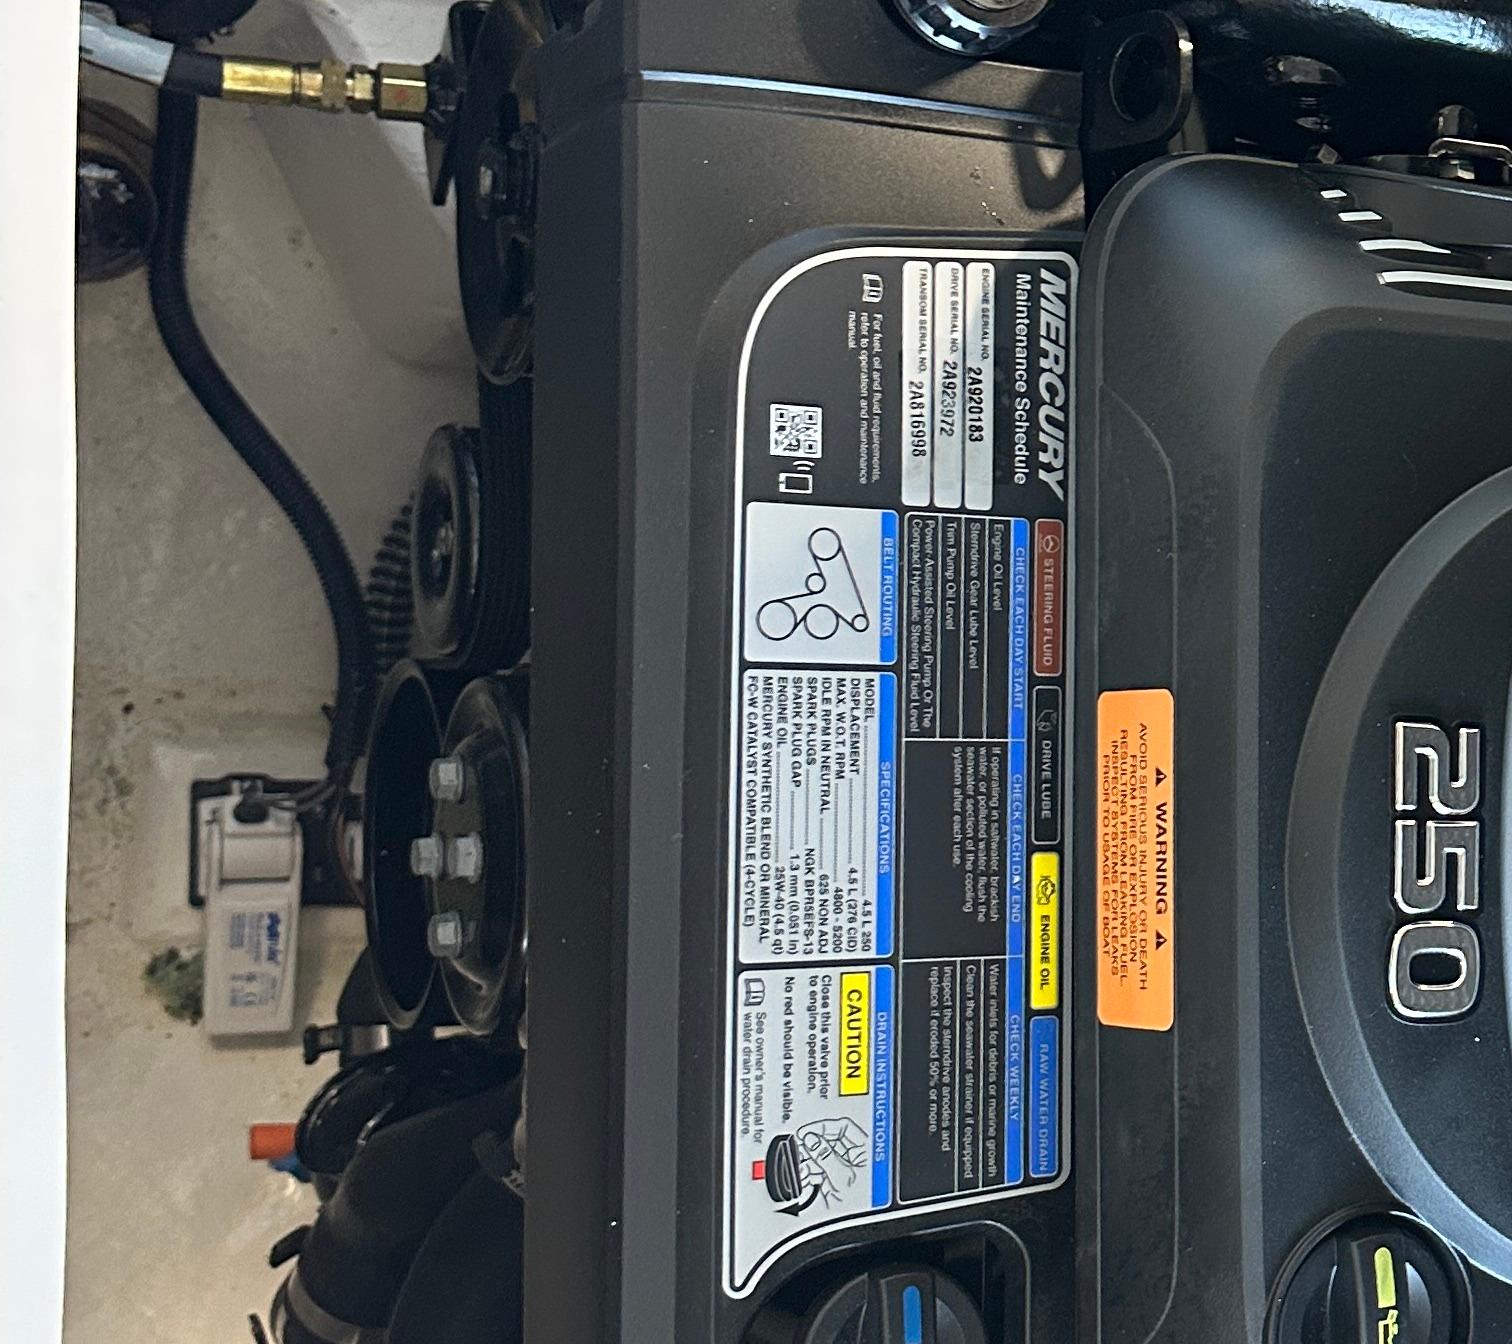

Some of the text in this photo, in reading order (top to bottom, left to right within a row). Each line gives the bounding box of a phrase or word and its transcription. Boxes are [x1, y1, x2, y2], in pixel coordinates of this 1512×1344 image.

[918, 268, 927, 316] TRANSOM
[949, 300, 958, 333] SERIAL
[950, 268, 959, 296] DRIVE
[981, 268, 989, 304] ENGINE
[918, 319, 926, 353] SERIAL
[981, 307, 989, 341] SERIAL
[940, 360, 957, 436] 2A923972
[968, 367, 983, 442] 2A920183
[1014, 273, 1031, 484] Maintenance Schedule
[1038, 268, 1066, 501] MERCURY
[909, 381, 926, 457] 2A816998
[882, 538, 893, 636] BELT ROUTING
[944, 522, 956, 630] Trim Pump Oil Level
[969, 522, 980, 669] Sterndrive Gear Lube Level
[992, 524, 1003, 611] Engine Oil Level
[908, 519, 922, 732] Compact Hydraulic Steering Fluid Level
[922, 520, 934, 727] Power-Assisted Steering Pump Or The
[1014, 547, 1024, 709] CHECK EACH DAY START
[1043, 558, 1054, 666] STEERING FLUID
[792, 676, 801, 718] SPARK
[807, 677, 816, 718] SPARK
[835, 678, 845, 706] MAX.
[849, 678, 859, 774] DISPLACEMENT
[865, 678, 874, 721] MODEL
[792, 722, 801, 756] PLUG
[806, 722, 816, 765] PLUGS
[835, 712, 845, 749] W.O.T.
[835, 752, 845, 779] RPM
[745, 675, 757, 927] FC-W CATALYST COMPATIBLE (4-CYCLE)
[759, 676, 772, 943] MERCURY SYNTHETIC BLEND OR MINERAL
[791, 760, 801, 787] GAP
[1041, 740, 1052, 819] DRIVE LUBE
[772, 676, 787, 955] ENGINE OIL 25W-40 (4.5 qt)
[818, 677, 831, 954] IDLE RPM IN NEUTRAL 625 NON ADJ
[880, 761, 890, 873] SPECIFICATIONS
[1012, 774, 1022, 923] CHECK EACH DAY END
[788, 874, 799, 896] mm
[789, 854, 799, 871] 1.3
[804, 848, 814, 874] NGK
[846, 867, 857, 884] 4.5
[1156, 802, 1167, 914] WARNING
[1388, 721, 1481, 1023] 250
[833, 886, 842, 914] 4800
[846, 898, 857, 923] (276
[862, 899, 871, 916] 4.5
[833, 925, 842, 953] 5200
[846, 927, 857, 952] CID)
[862, 931, 871, 952] 250
[1040, 915, 1050, 990] ENGINE OIL
[965, 965, 976, 997] Clean
[965, 1000, 976, 1017] the
[782, 976, 794, 1124] No red should be visible.
[806, 975, 819, 1094] to engine operation.
[819, 975, 831, 1099] Close this valve prior
[845, 989, 861, 1078] CAUTION
[964, 1020, 975, 1069] seawater
[1009, 1015, 1020, 1121] CHECK WEEKLY
[875, 1011, 887, 1162] DRAIN INSTRUCTIONS
[964, 1073, 975, 1113] strainer
[1038, 1043, 1049, 1171] RAW WATER DRAIN
[964, 1126, 975, 1178] equipped
